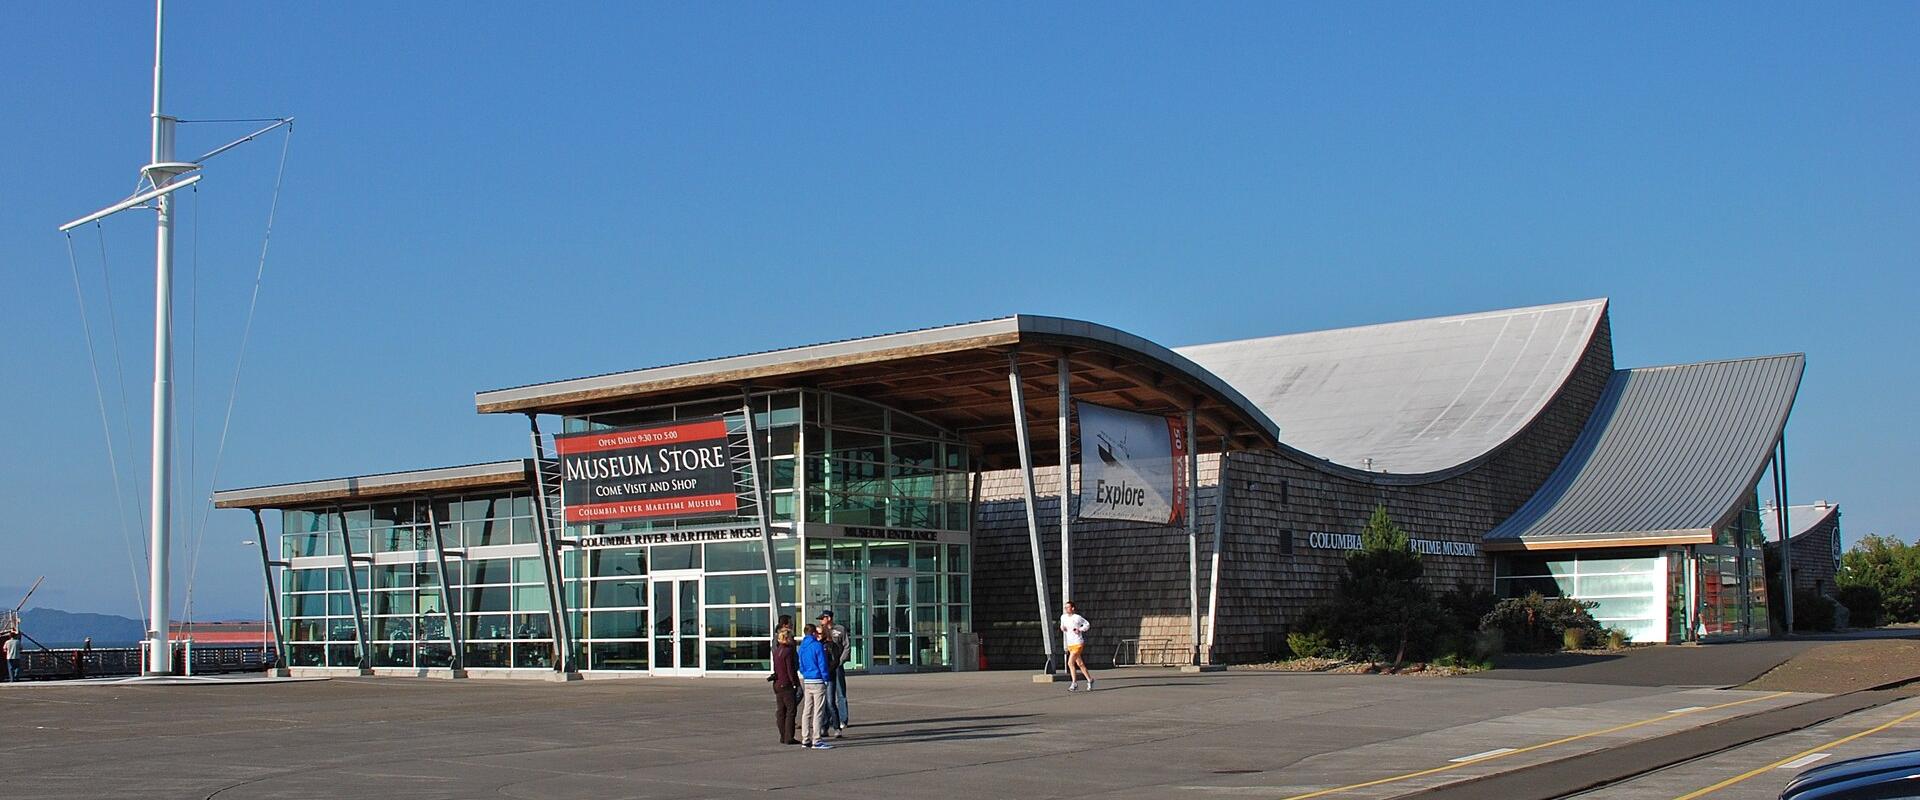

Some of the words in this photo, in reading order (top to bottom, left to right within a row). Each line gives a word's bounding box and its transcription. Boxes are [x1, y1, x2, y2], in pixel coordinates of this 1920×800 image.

[598, 438, 616, 447] OPEN
[618, 434, 637, 444] DAILY
[638, 432, 652, 442] 9:30
[653, 433, 663, 441] TO
[664, 430, 678, 440] 5:00
[1173, 427, 1182, 450] 50
[566, 454, 653, 481] MUSEUM
[658, 446, 725, 473] STORE
[596, 485, 622, 497] COME
[624, 483, 647, 494] VISIT
[650, 481, 670, 492] AND
[671, 479, 697, 491] SHOP
[1096, 479, 1145, 510] Explore
[578, 508, 617, 517] COLUMBIA
[620, 506, 643, 514] RIVER
[645, 503, 685, 512] MARITIME
[688, 500, 722, 509] MUSEUM
[581, 535, 632, 548] COLUMBIA
[634, 531, 667, 545] RIVER
[670, 528, 728, 542] MARITIME
[844, 527, 885, 539] MUSEUM
[886, 530, 938, 541] ENTRANCE
[1309, 531, 1363, 550] COLUMBIA
[1409, 538, 1441, 555] RITIME
[1442, 541, 1476, 557] MUSEUM
